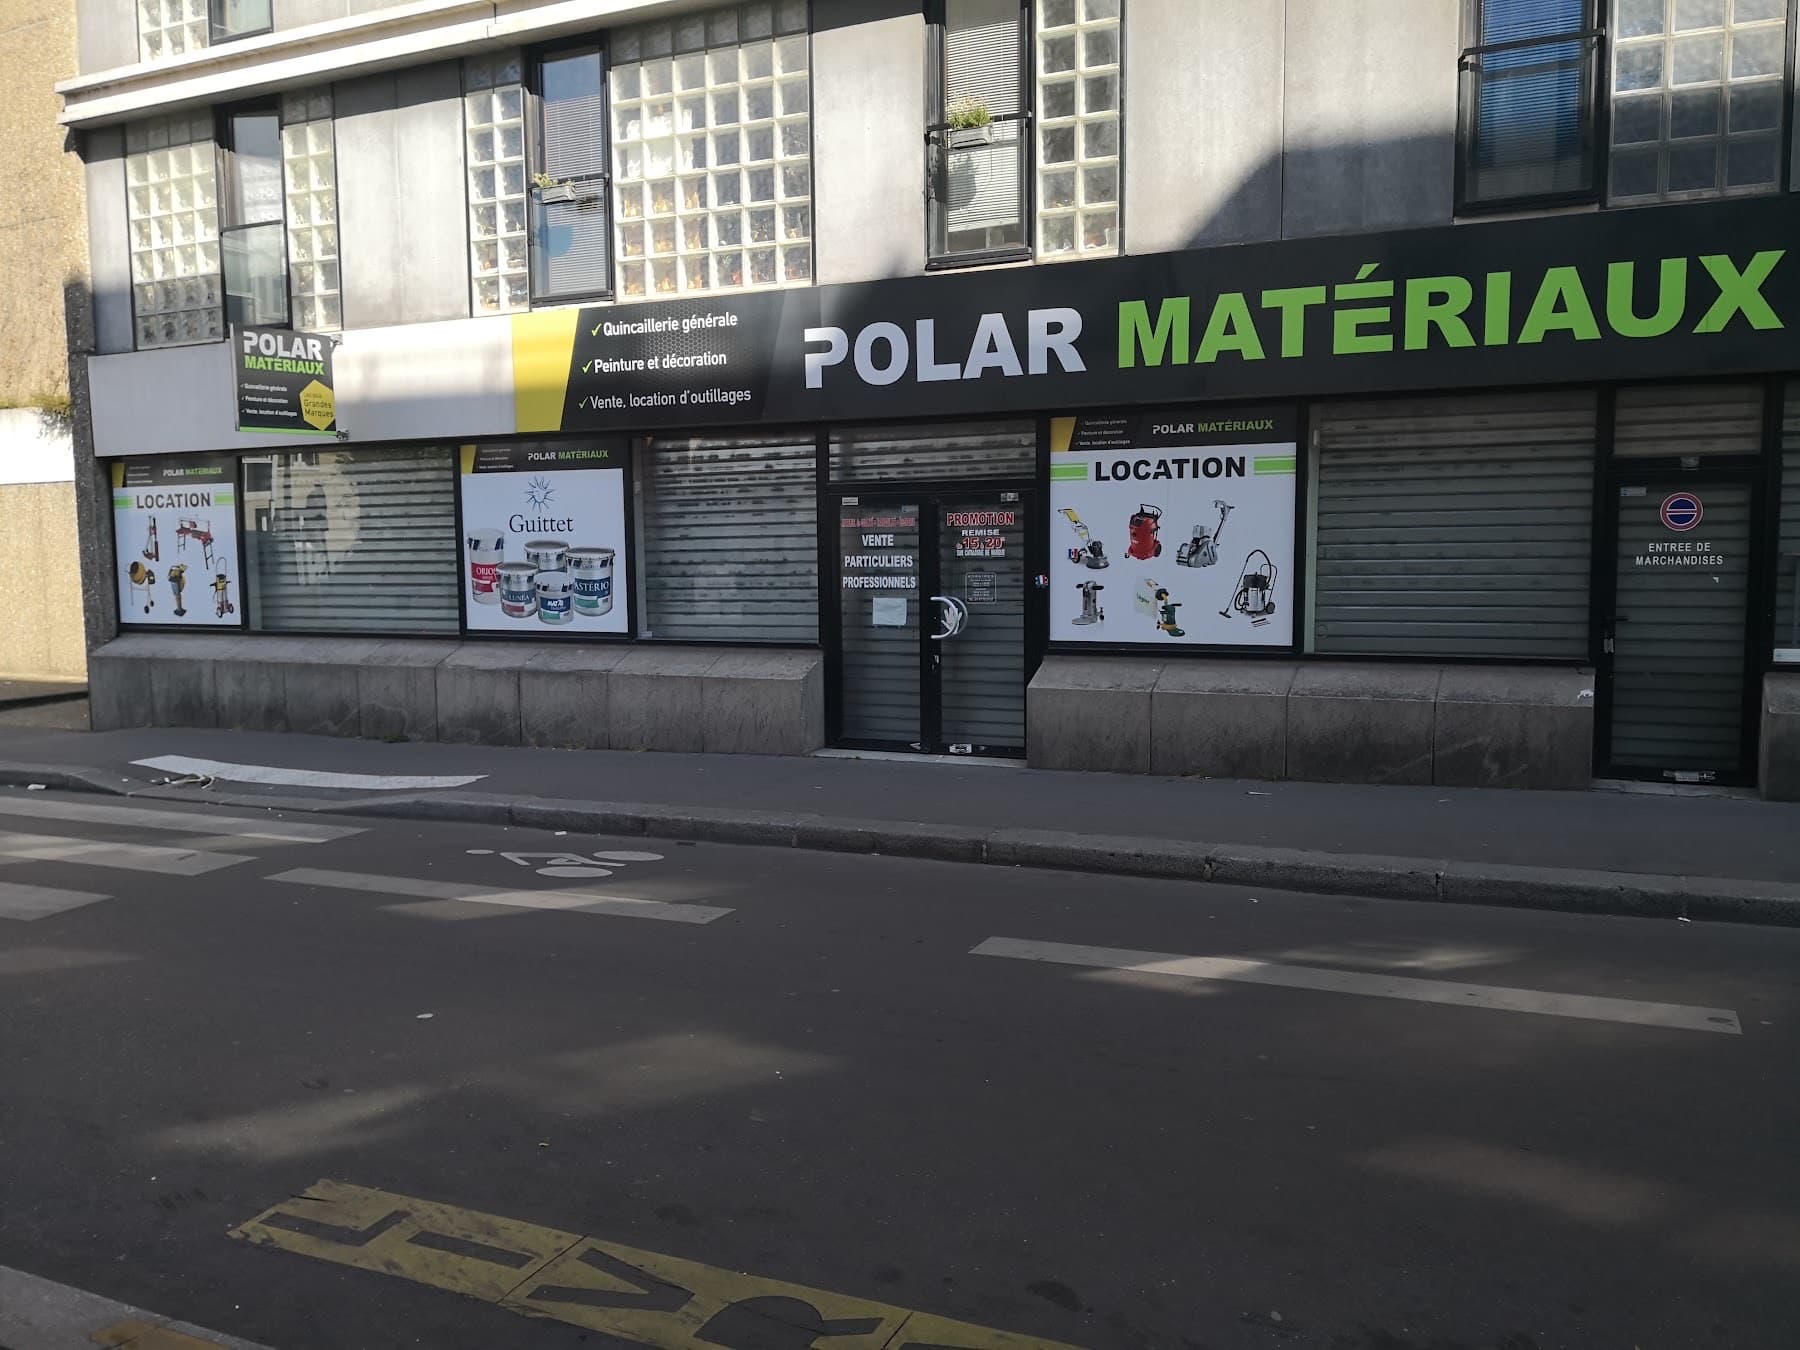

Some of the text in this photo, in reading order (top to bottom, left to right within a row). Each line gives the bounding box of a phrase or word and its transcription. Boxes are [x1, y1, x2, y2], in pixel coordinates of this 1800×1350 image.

[603, 312, 738, 337] Quincaillerie générale
[803, 250, 1786, 389] POLAR MATÉRIAUX
[243, 331, 323, 361] POLAR
[244, 355, 324, 375] MATÉRIAUX
[594, 352, 727, 373] Peinture et décoration
[590, 388, 752, 409] Vente, location d'outillages
[305, 408, 333, 418] Marques
[1152, 420, 1273, 435] POLAR MATÉRIAUX
[528, 451, 556, 460] POLAR
[1095, 456, 1246, 481] LOCATION
[136, 492, 211, 509] LOCATION
[509, 514, 574, 532] Guittet
[946, 511, 1015, 527] PROMOTION
[862, 534, 894, 547] VENTE
[961, 528, 1000, 537] REMISE
[1648, 542, 1711, 552] ENTREE DE
[844, 555, 914, 568] PARTICULIERS
[1635, 555, 1723, 566] MARCHANDISES
[842, 576, 916, 588] PROFESSIONNELS
